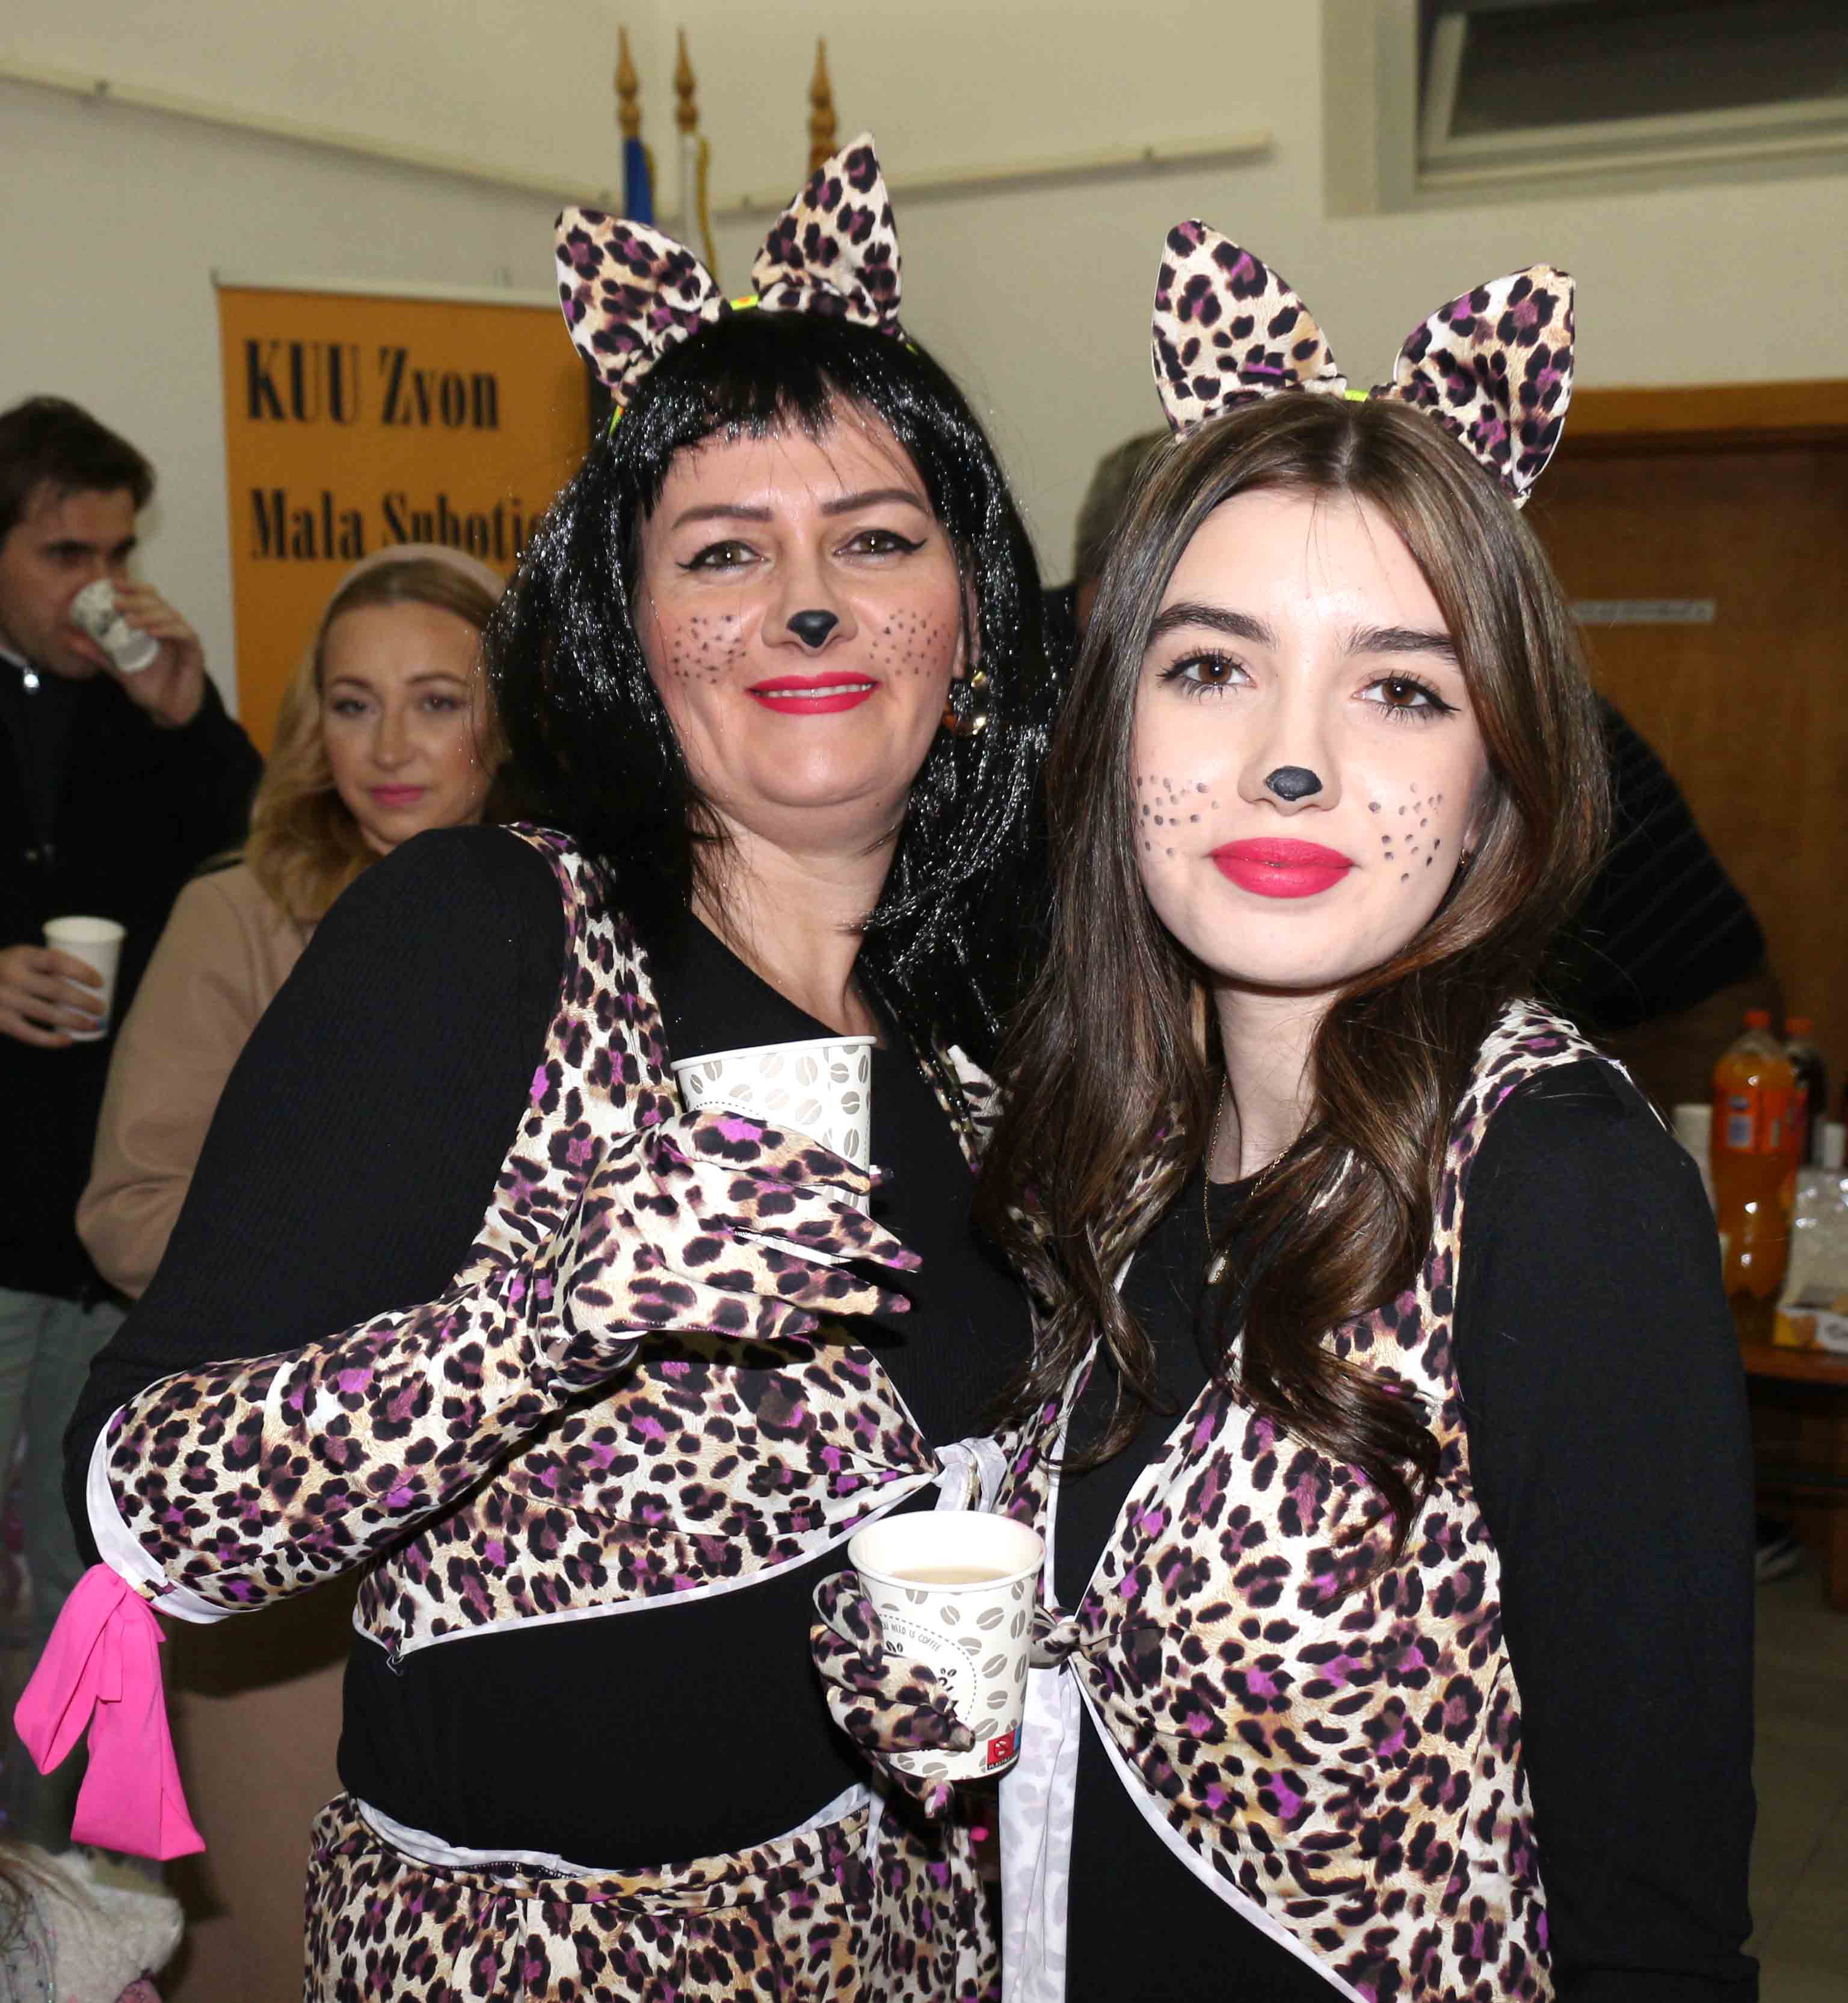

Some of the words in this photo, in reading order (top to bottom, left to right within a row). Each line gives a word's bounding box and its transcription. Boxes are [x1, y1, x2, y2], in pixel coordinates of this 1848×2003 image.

[245, 339, 359, 423] KUU
[379, 346, 499, 429] Zvon
[250, 488, 365, 561] Mala
